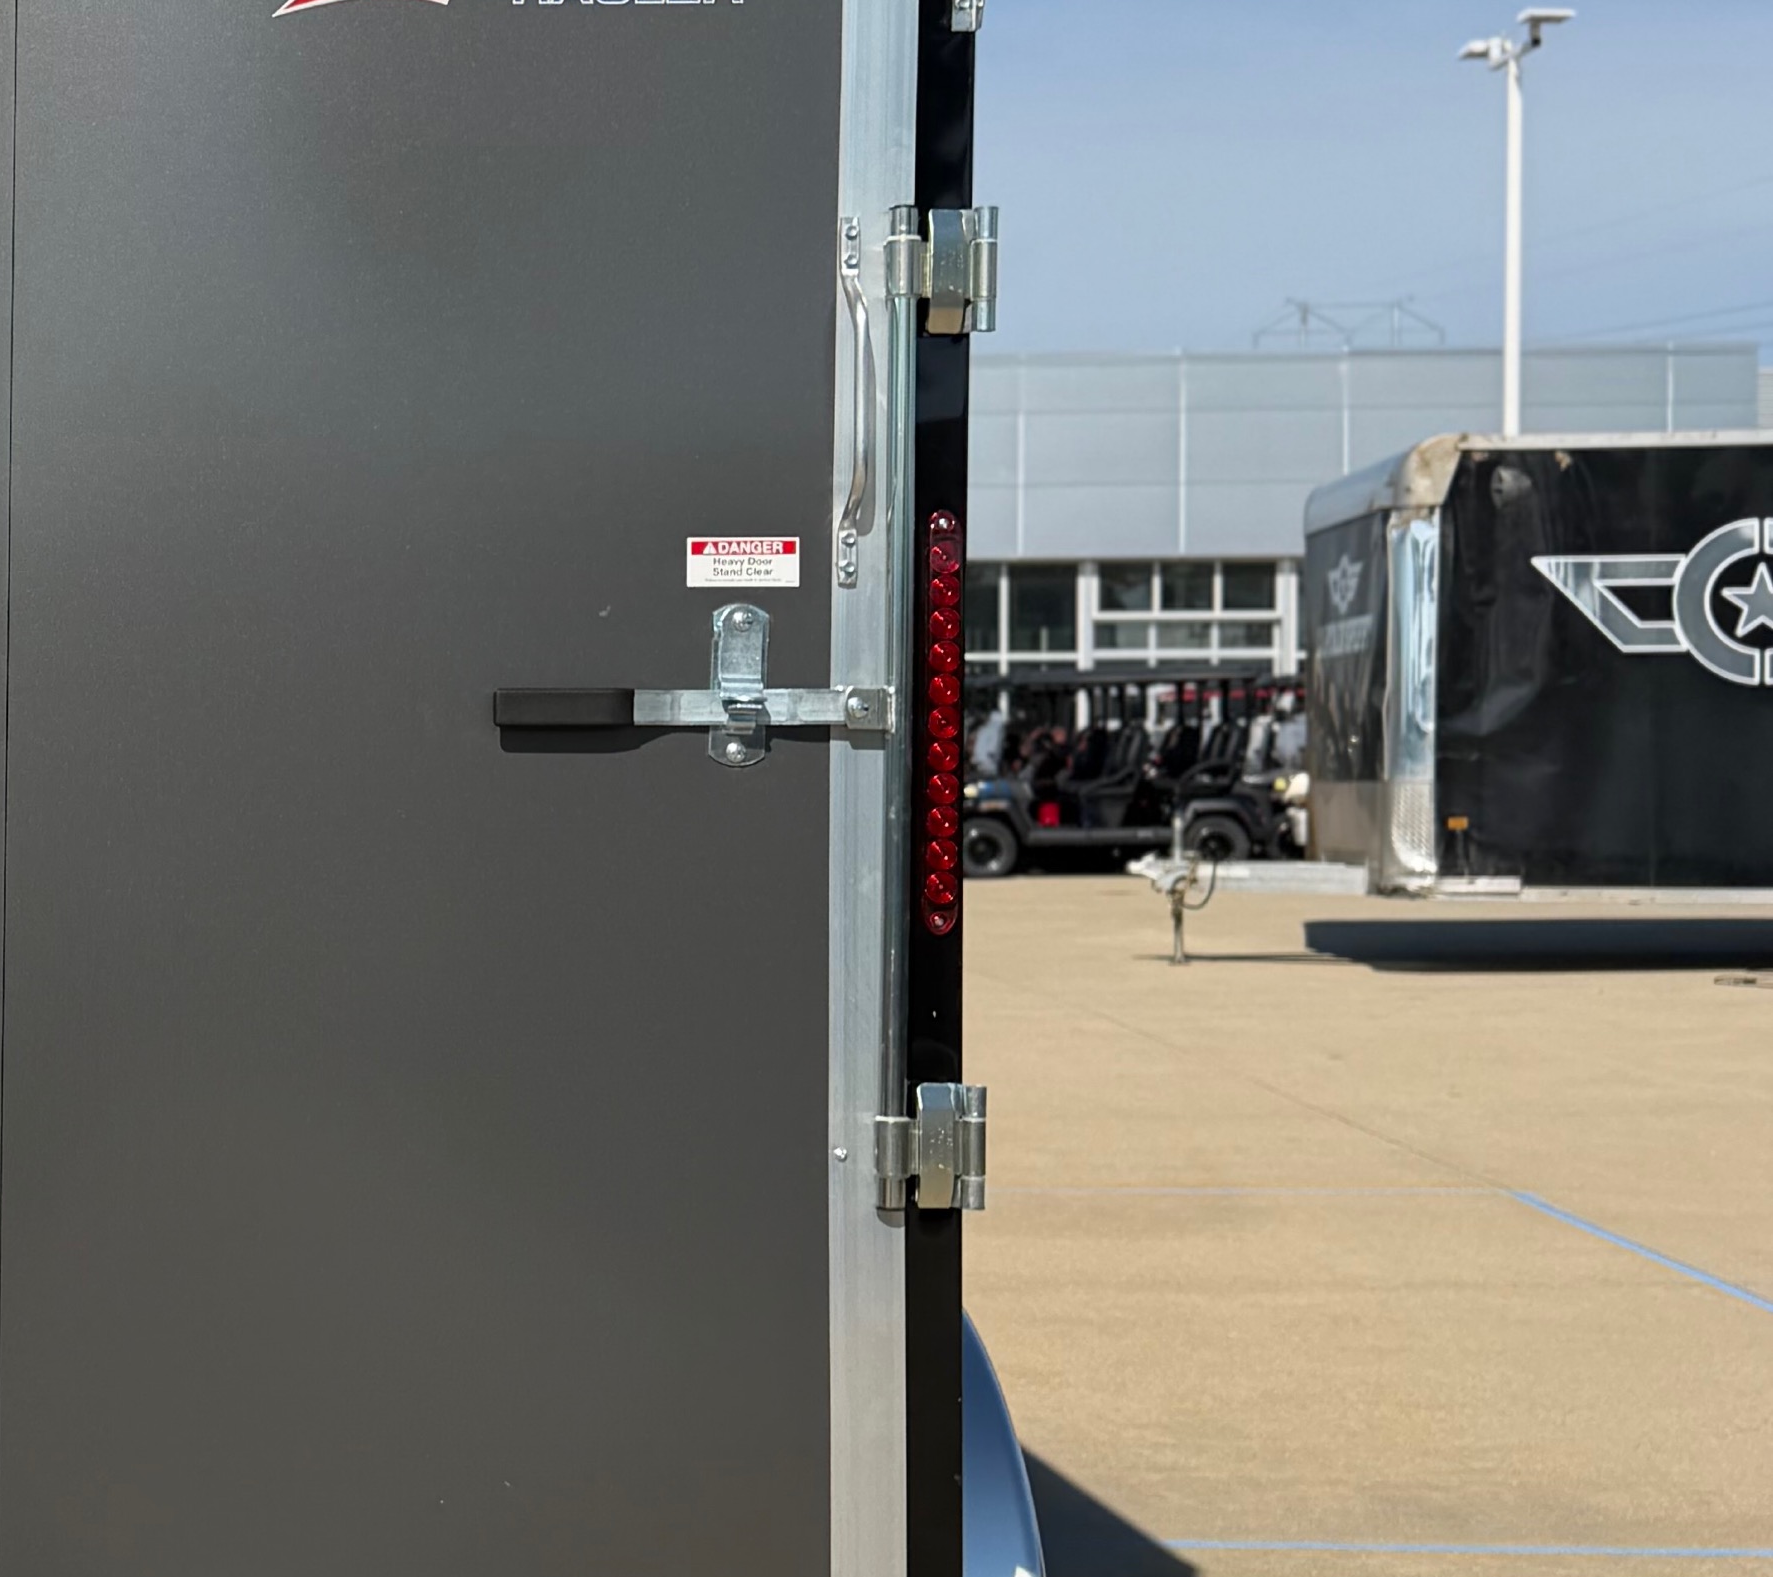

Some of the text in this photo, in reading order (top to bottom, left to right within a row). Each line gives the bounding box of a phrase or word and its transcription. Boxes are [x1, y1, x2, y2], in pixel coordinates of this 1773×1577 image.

[717, 541, 784, 554] DANGER
[712, 557, 773, 569] Heavy Door
[712, 567, 773, 577] Stand Clear
